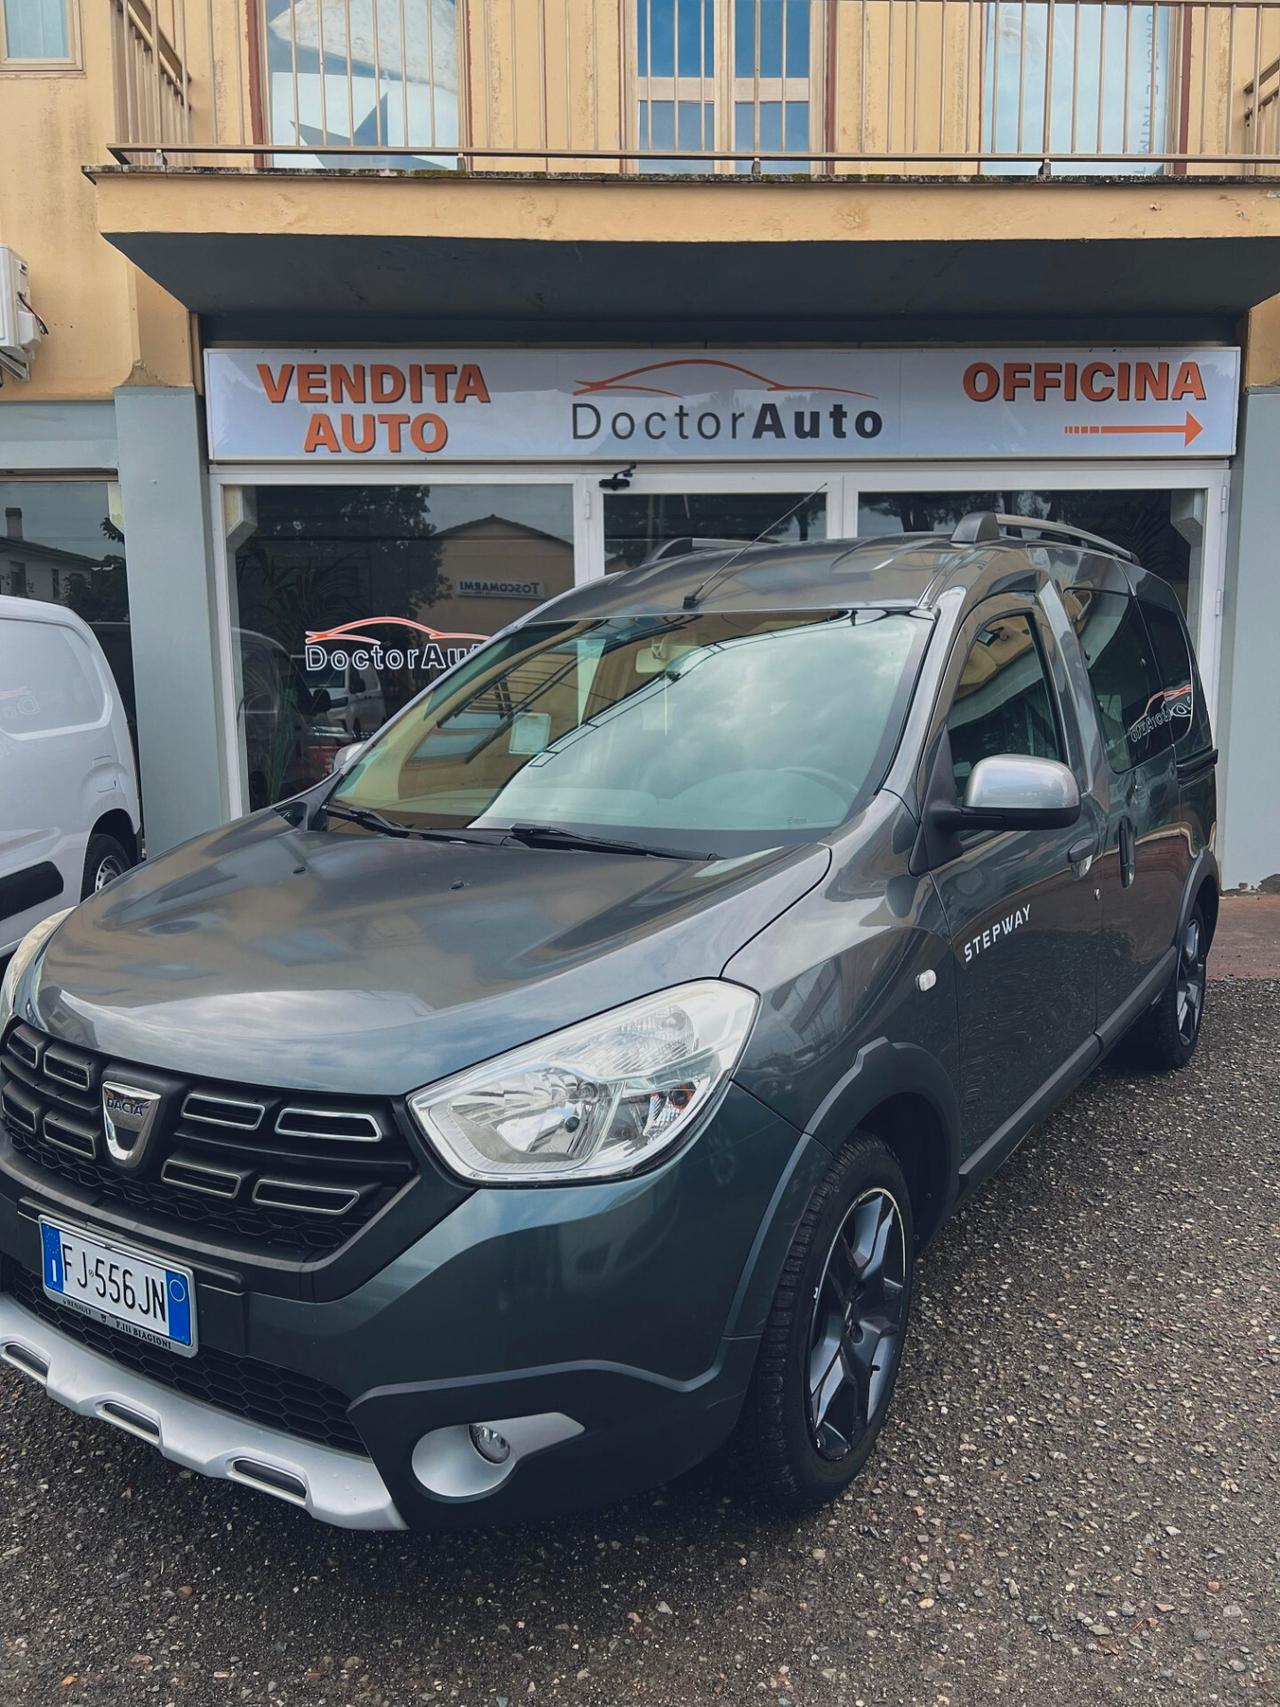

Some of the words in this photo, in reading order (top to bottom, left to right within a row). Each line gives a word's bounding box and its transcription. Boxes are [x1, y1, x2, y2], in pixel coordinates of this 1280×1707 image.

[257, 363, 492, 404] VENDITA
[962, 361, 1206, 402] OFFICINA
[303, 414, 448, 453] AUTO
[572, 402, 883, 441] DoctorAuto
[305, 643, 482, 671] DoctorAu
[964, 903, 1030, 963] STEPWAY
